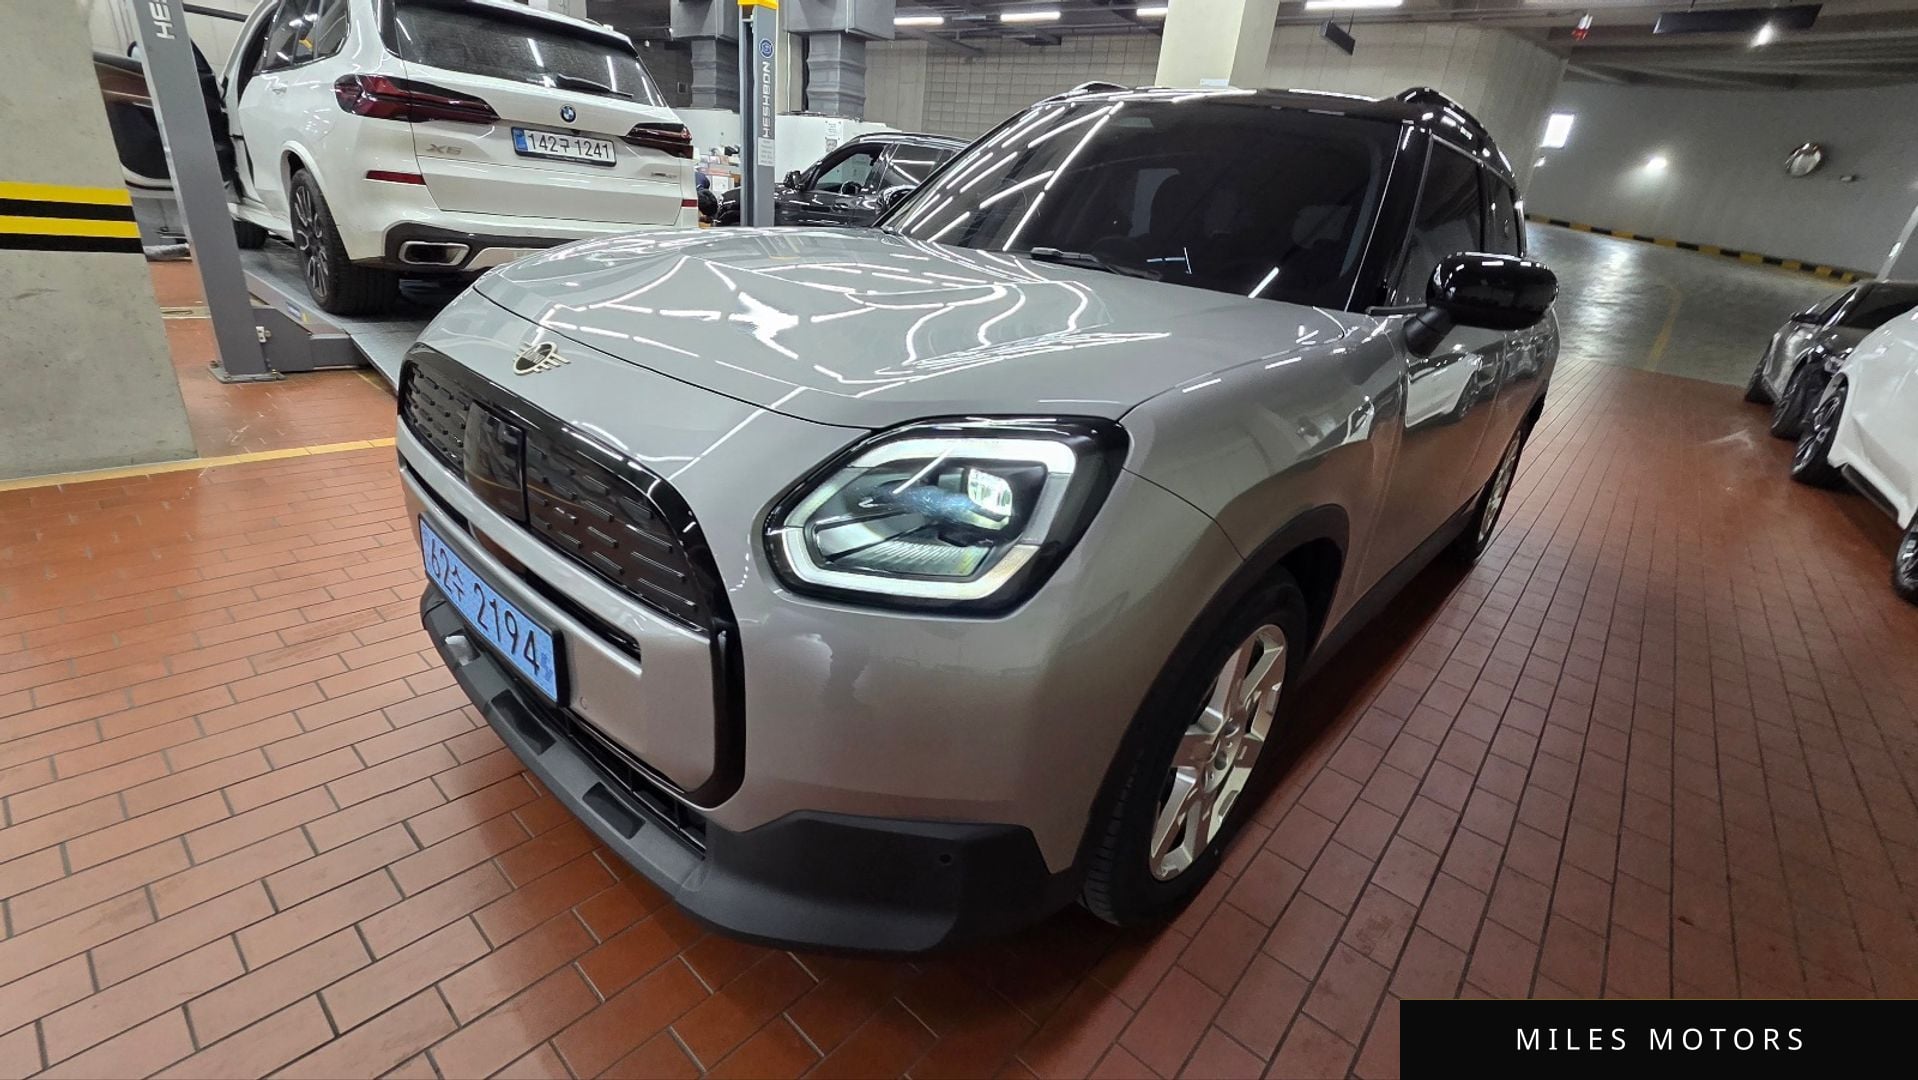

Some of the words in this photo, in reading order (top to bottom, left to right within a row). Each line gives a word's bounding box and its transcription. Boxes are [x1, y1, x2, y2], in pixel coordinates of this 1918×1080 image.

[148, 0, 176, 40] HE
[762, 61, 771, 138] HESHBON
[528, 133, 570, 153] 142구
[574, 139, 610, 159] 1241
[431, 538, 465, 602] 62수
[473, 582, 540, 678] 2194
